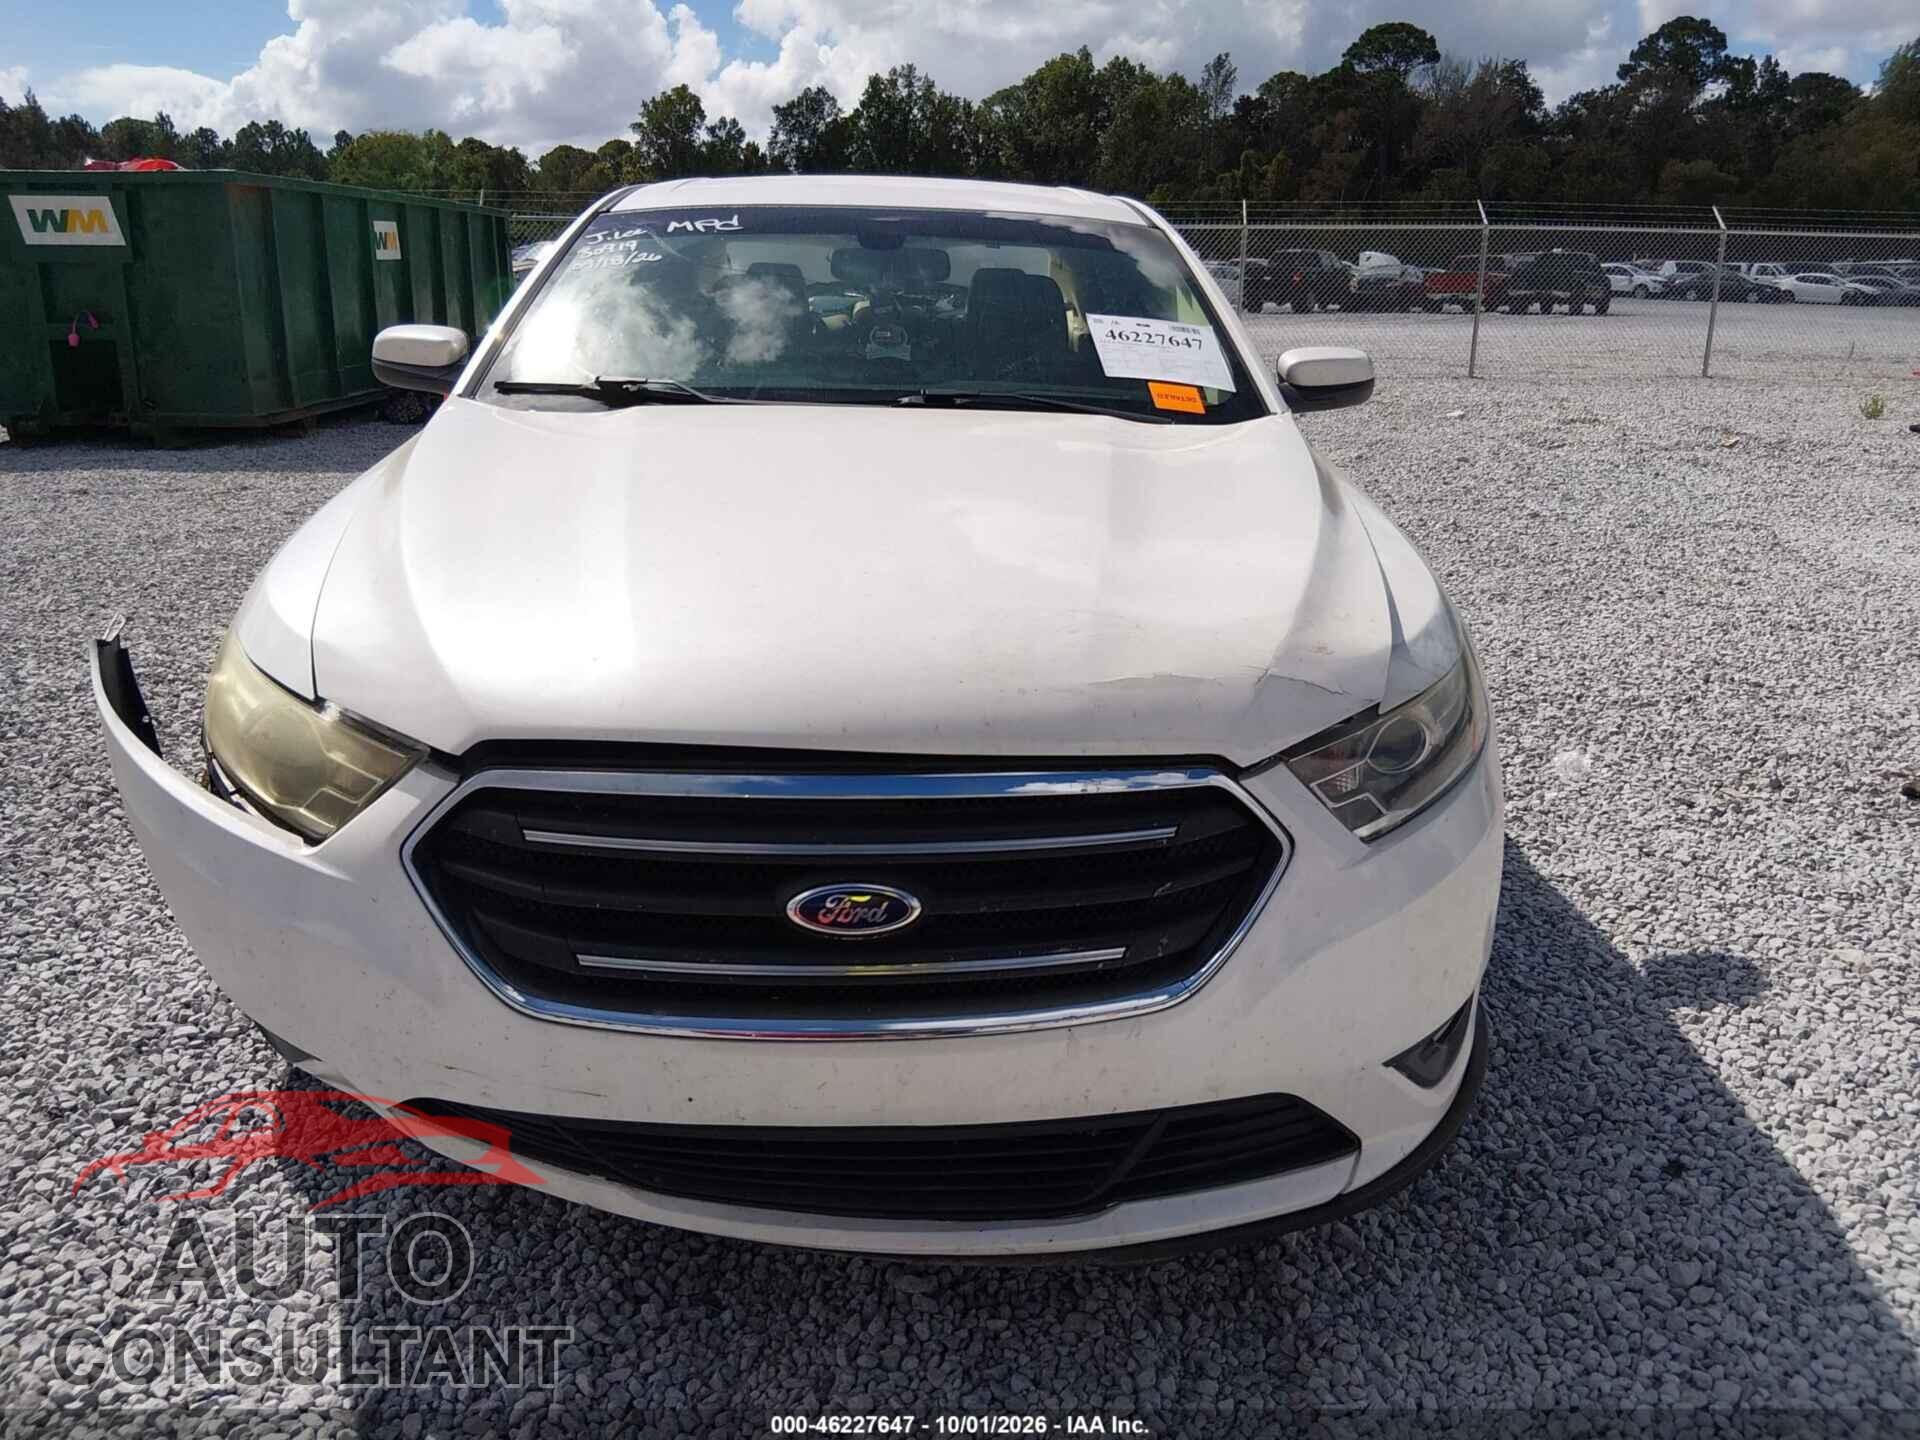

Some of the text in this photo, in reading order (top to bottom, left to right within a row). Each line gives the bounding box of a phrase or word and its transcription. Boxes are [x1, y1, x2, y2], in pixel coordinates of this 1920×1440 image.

[26, 208, 109, 233] WM
[375, 231, 398, 250] WM
[1105, 329, 1203, 351] 46227647
[817, 893, 889, 925] Ford
